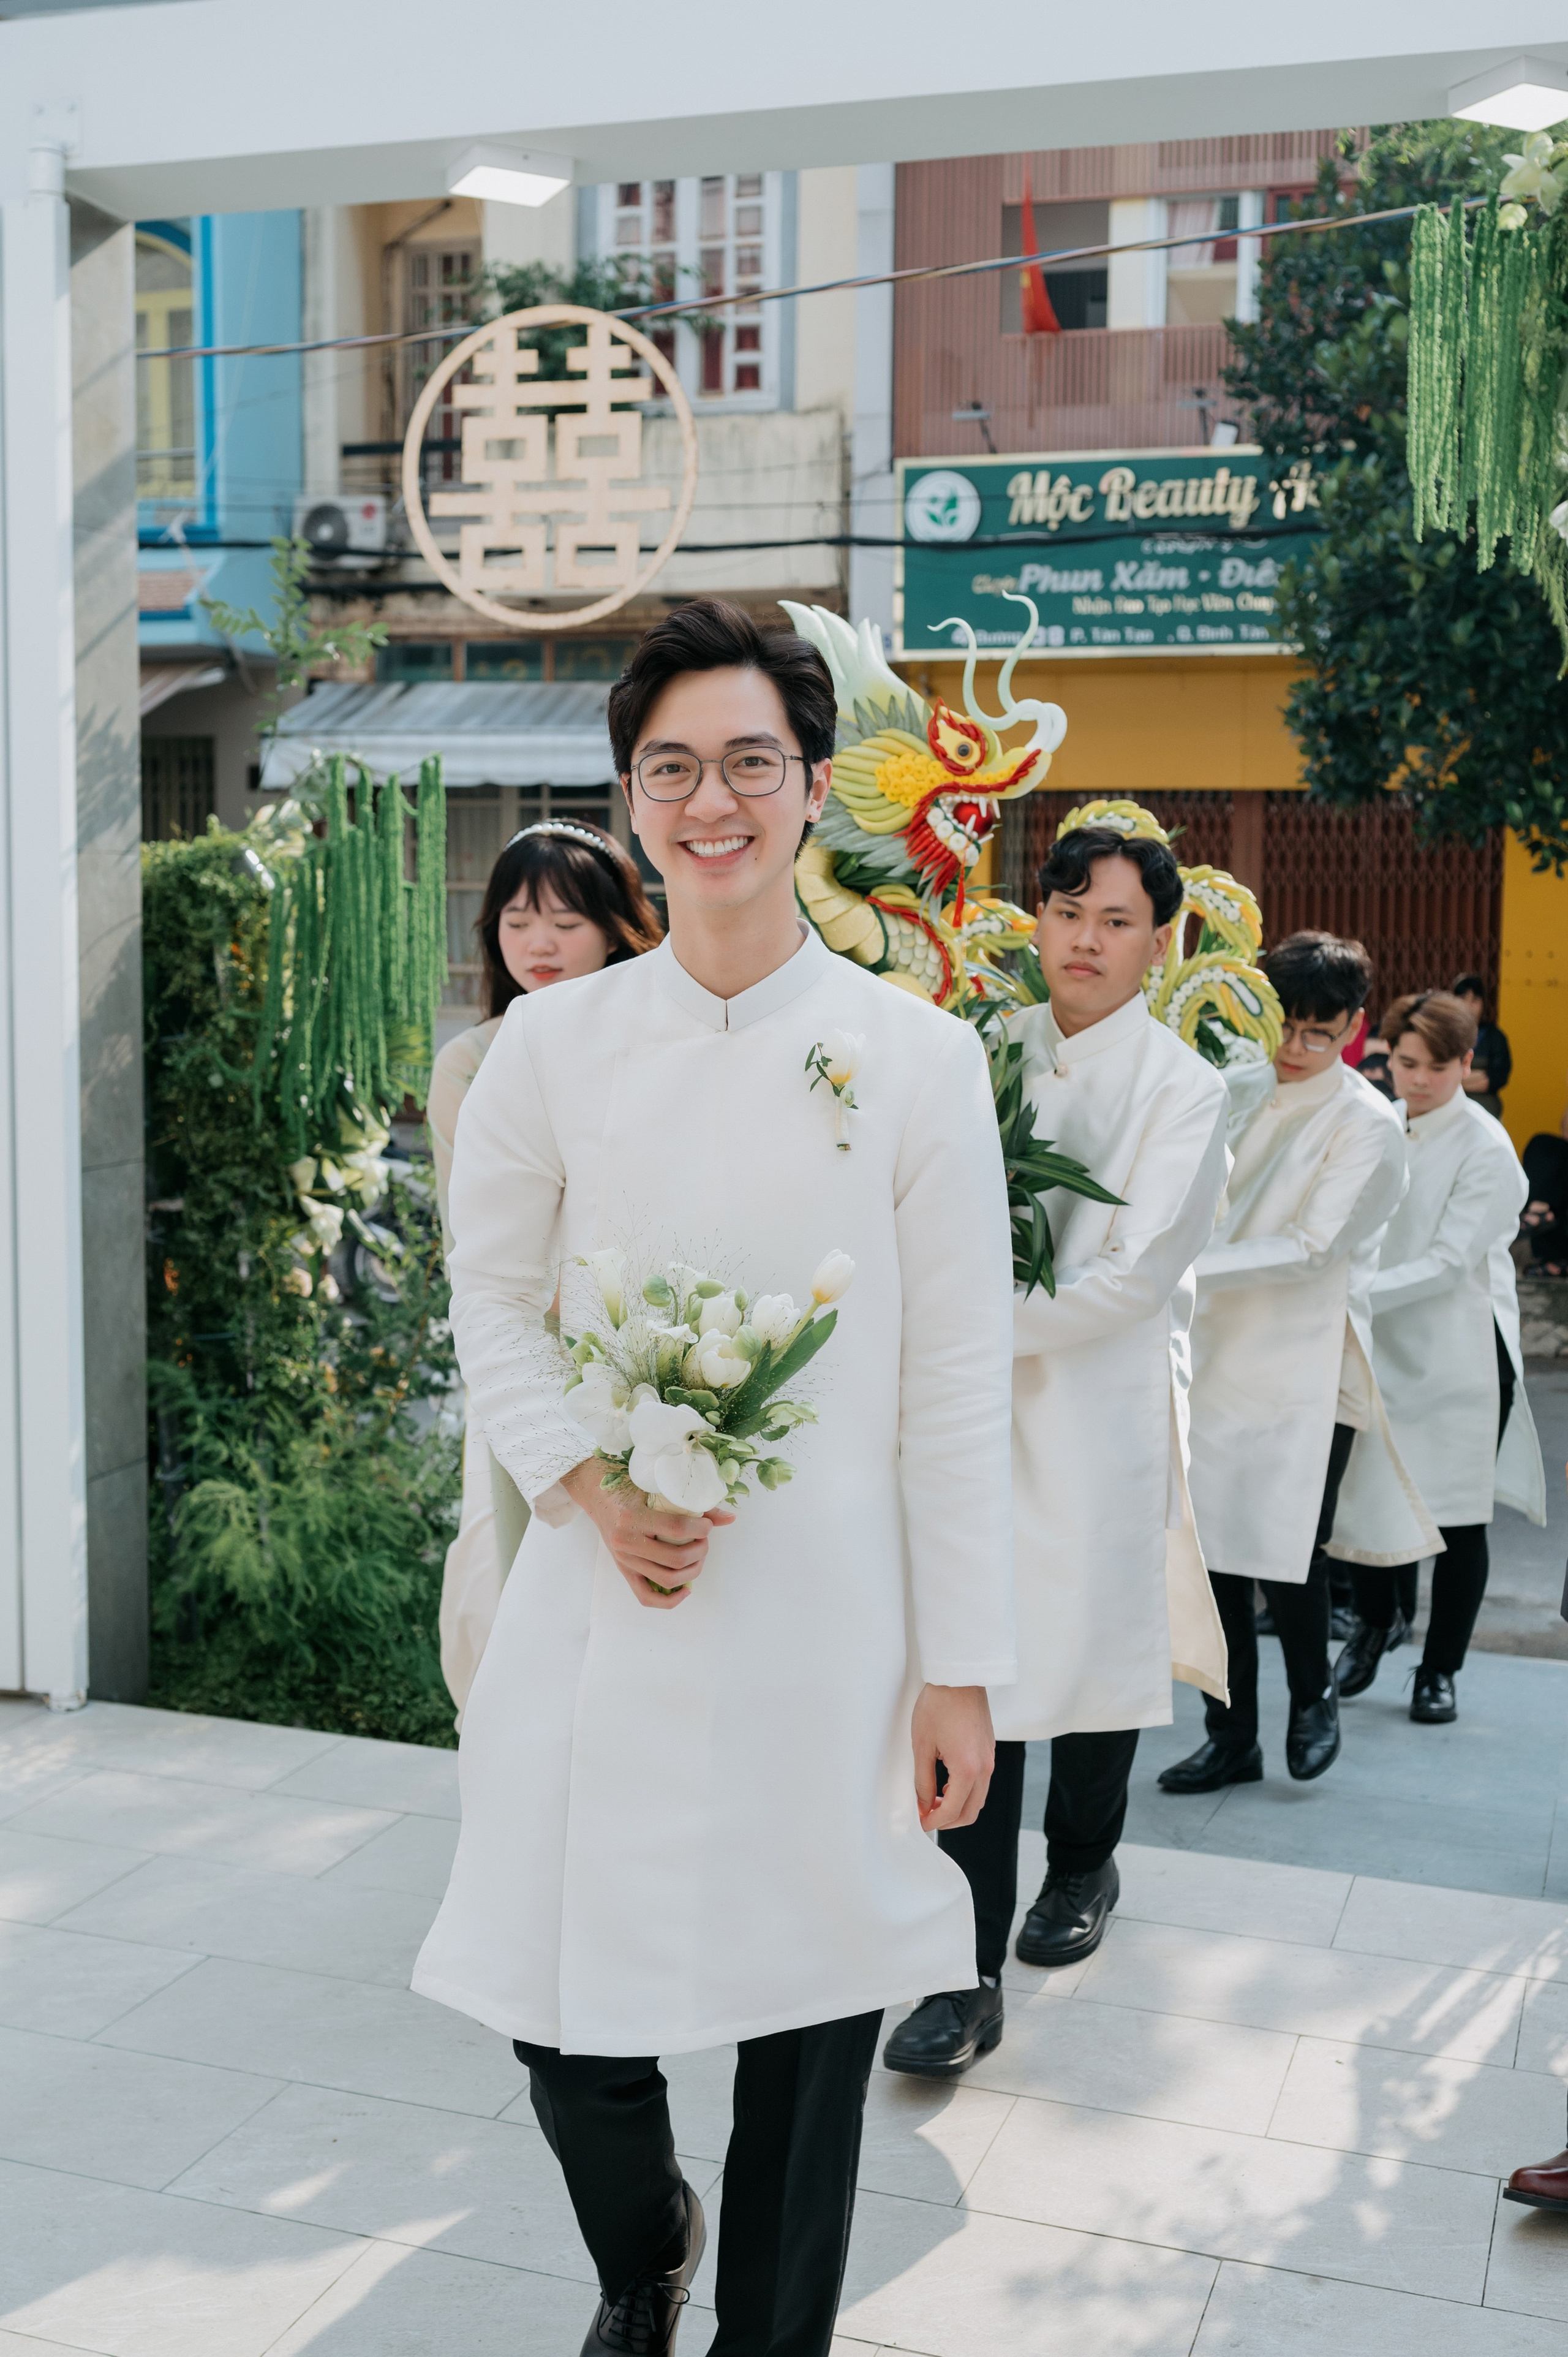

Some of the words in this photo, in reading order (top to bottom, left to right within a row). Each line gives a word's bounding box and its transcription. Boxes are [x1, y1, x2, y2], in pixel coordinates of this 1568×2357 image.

[1007, 469, 1095, 531] Mộc
[1099, 466, 1261, 530] Beauty
[1017, 562, 1104, 594] Phun
[1110, 560, 1191, 591] Xăm
